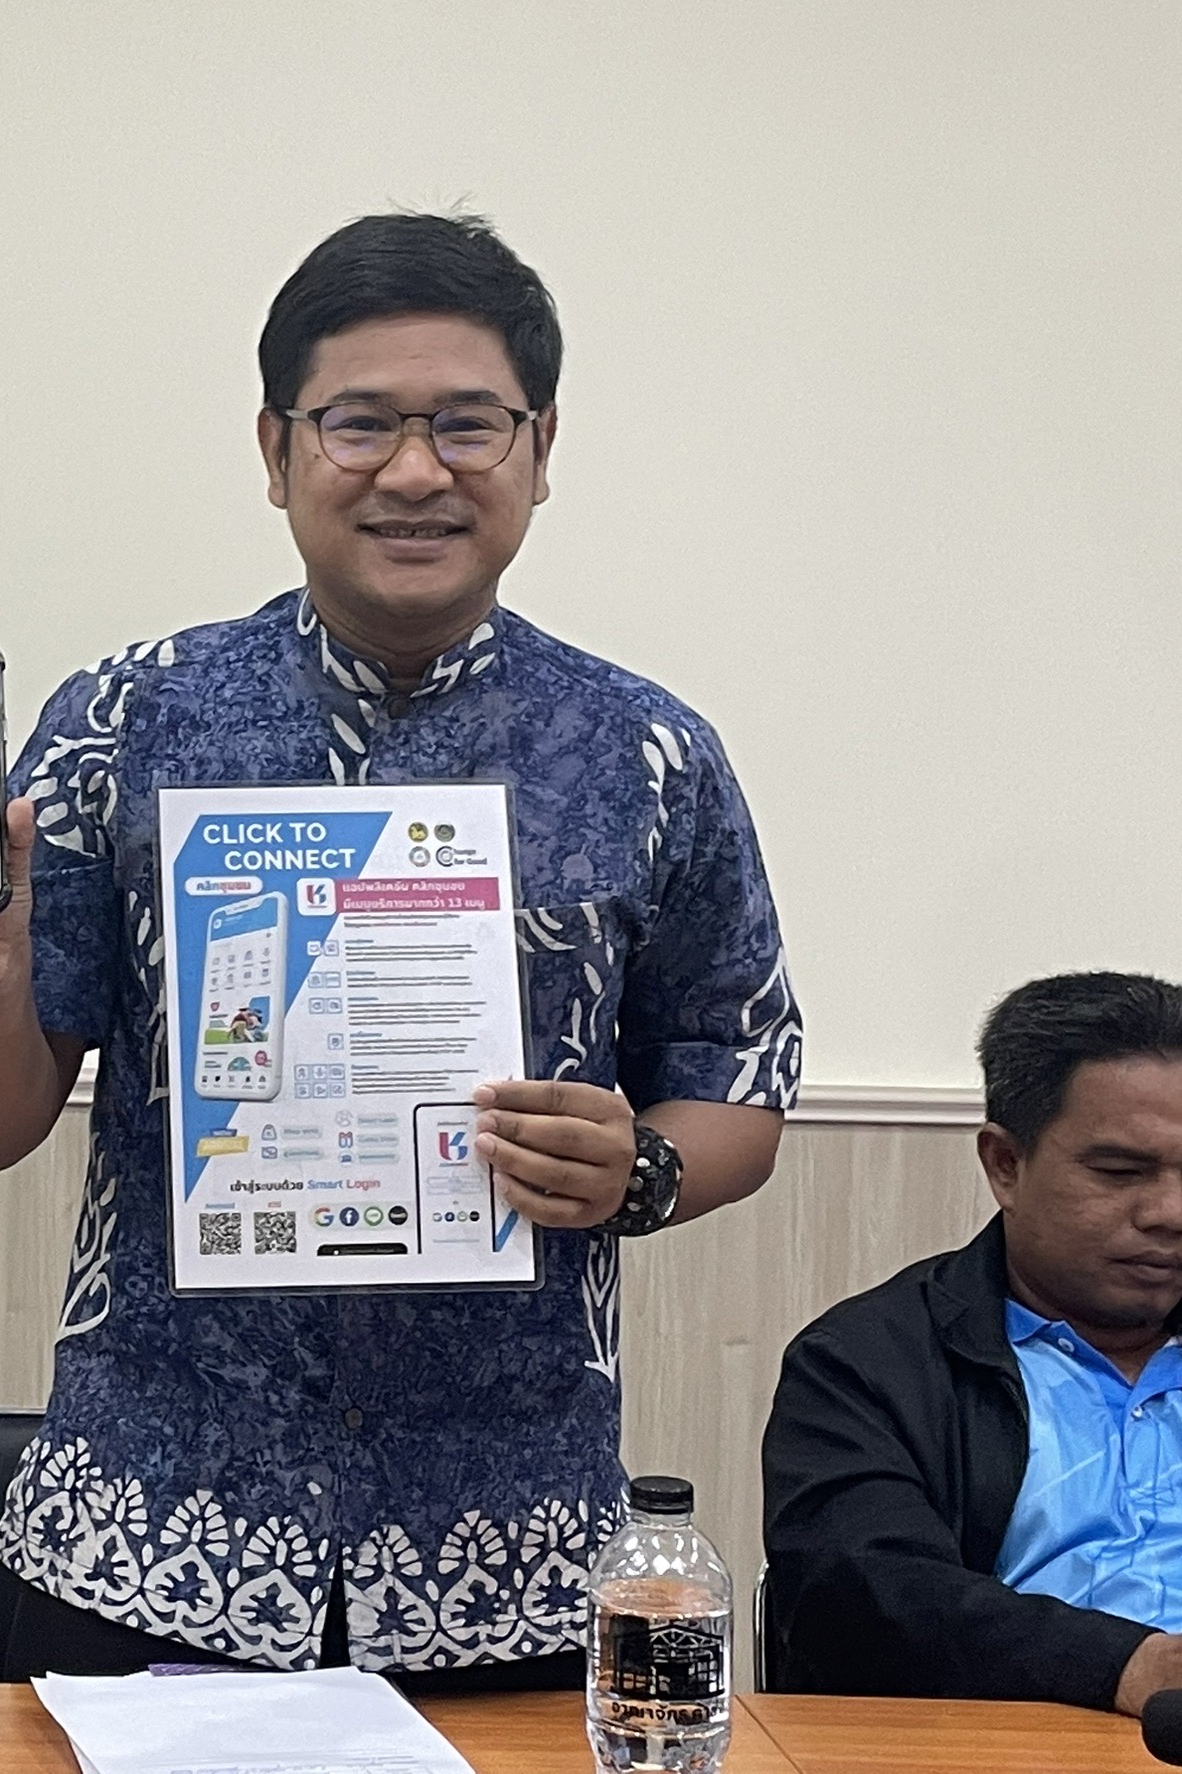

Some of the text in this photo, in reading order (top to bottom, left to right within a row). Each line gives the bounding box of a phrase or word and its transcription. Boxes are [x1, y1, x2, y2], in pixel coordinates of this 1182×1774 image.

[203, 822, 326, 844] CLICK TO
[224, 848, 356, 871] CONNECT
[307, 1180, 343, 1190] Smart
[346, 1179, 381, 1191] Login
